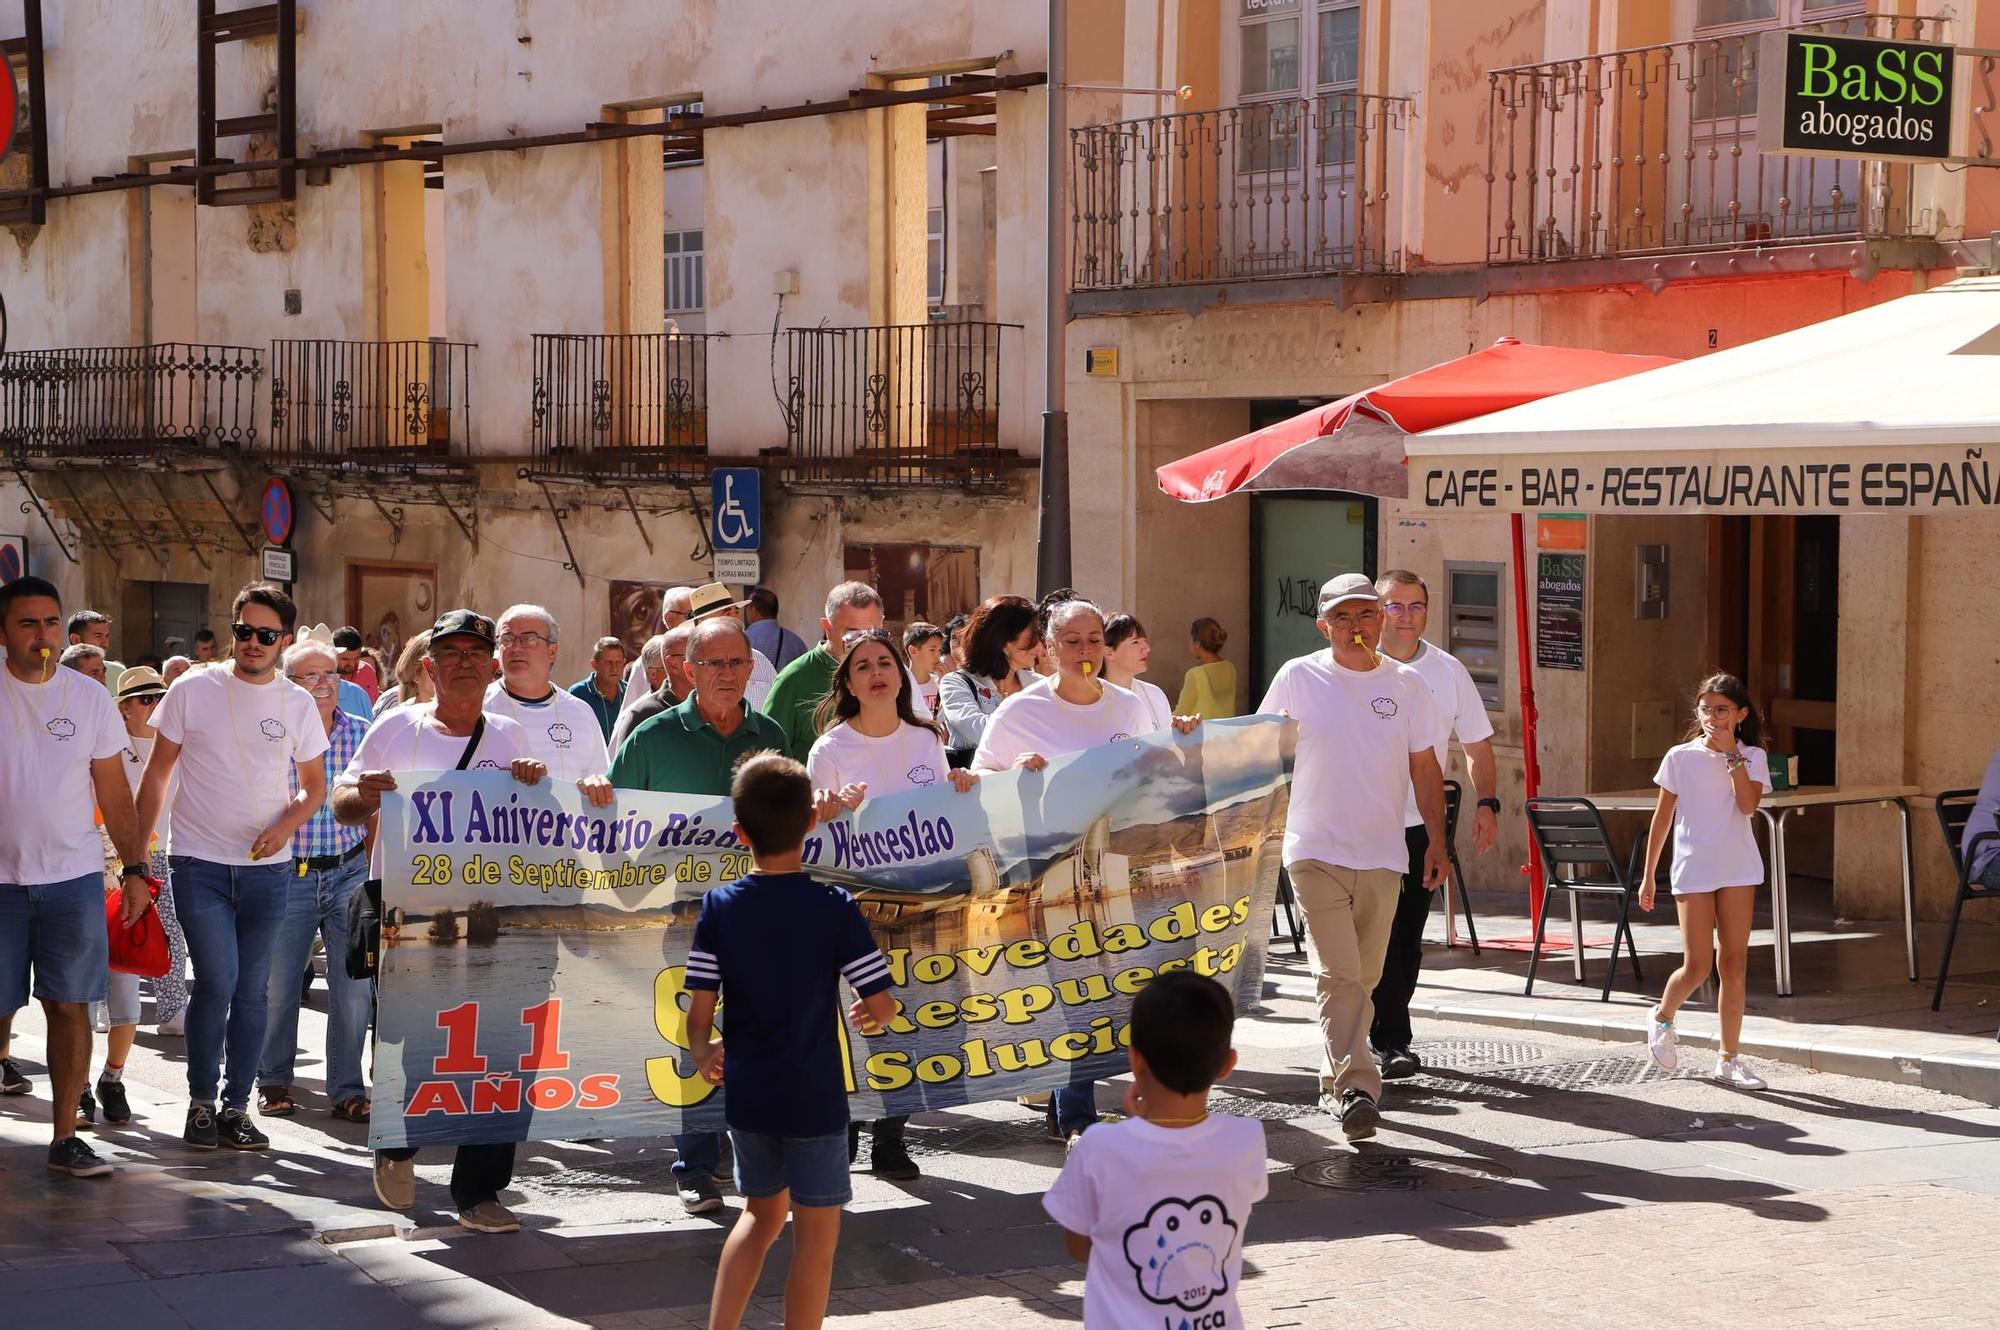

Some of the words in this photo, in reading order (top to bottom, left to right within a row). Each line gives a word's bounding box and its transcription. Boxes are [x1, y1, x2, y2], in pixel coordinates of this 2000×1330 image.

[1797, 42, 1944, 106] BaSS
[1800, 100, 1933, 145] abogados
[1710, 330, 1717, 347] 2
[1425, 470, 1497, 506] CAFE
[1521, 468, 1580, 506] BAR
[1601, 464, 1850, 507] RESTAURANTE
[1861, 448, 2000, 507] ESPAÑ
[1540, 577, 1581, 593] abogados
[1541, 557, 1583, 578] BaSS
[411, 790, 454, 843] XI
[465, 790, 653, 854] Aniversario
[658, 812, 750, 852] Riad
[827, 809, 954, 870] Wenceslao
[411, 854, 451, 885] 28
[462, 854, 501, 884] de
[508, 855, 665, 893] Septiembre
[675, 855, 712, 882] de
[860, 929, 1248, 1037] espueta
[403, 1072, 621, 1116] AÑOS
[1184, 1285, 1207, 1300] 2012
